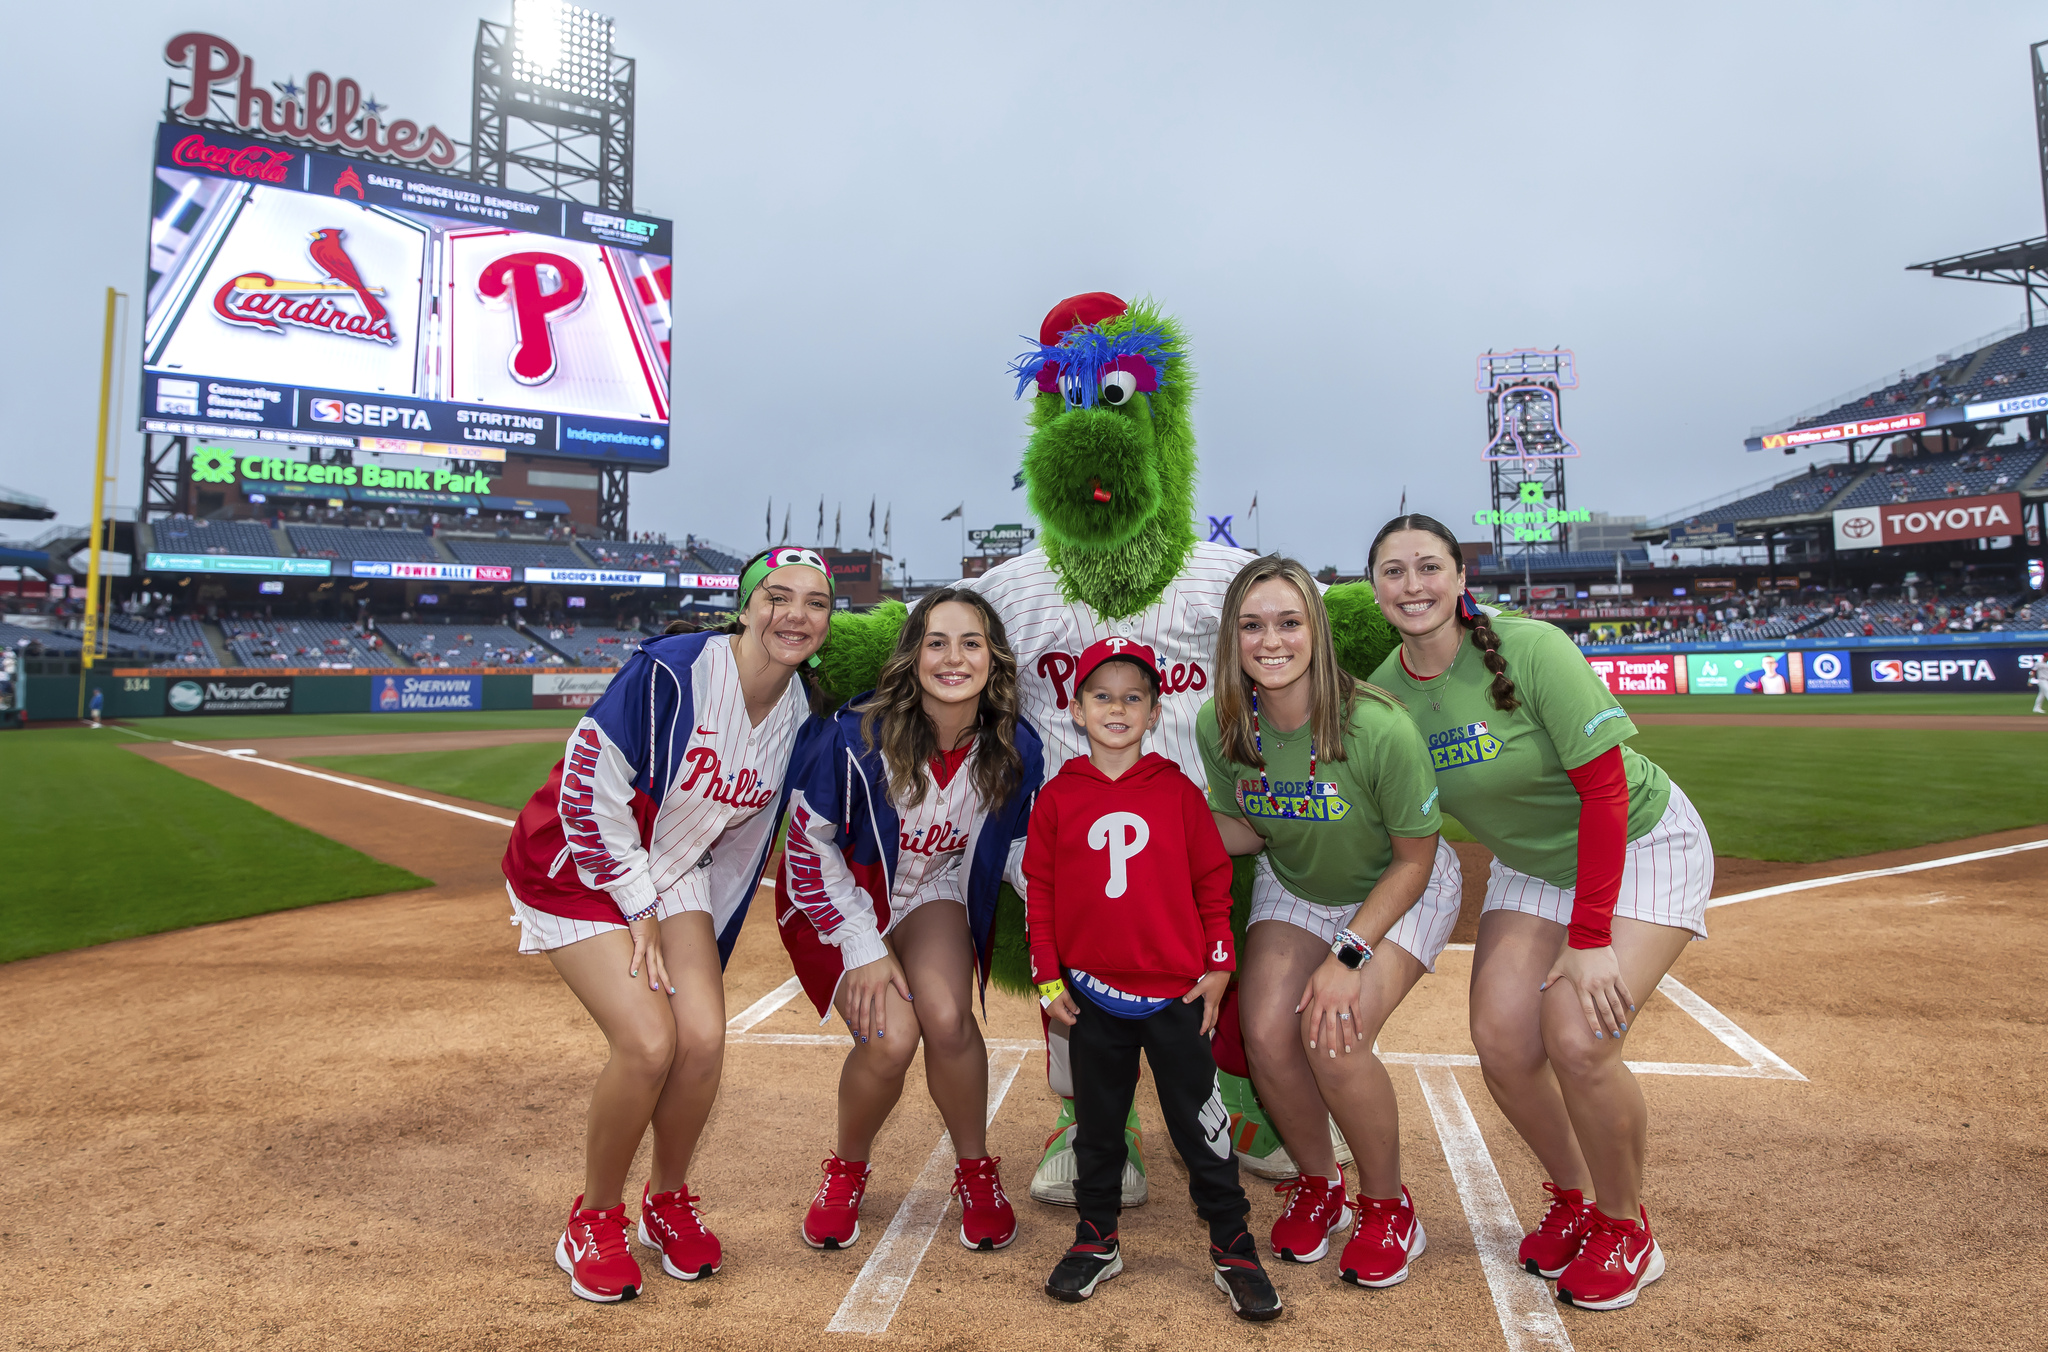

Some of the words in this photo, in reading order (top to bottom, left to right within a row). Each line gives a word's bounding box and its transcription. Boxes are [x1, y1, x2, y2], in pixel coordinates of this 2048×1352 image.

[164, 32, 457, 168] Phillies
[367, 174, 404, 190] SALTZ
[484, 195, 541, 215] BENDESKY
[402, 192, 448, 209] INJURY
[454, 202, 509, 220] LAWYERS
[625, 219, 659, 237] BET
[212, 273, 398, 346] Cardinals
[476, 251, 588, 387] P
[208, 383, 281, 403] Connecting
[344, 403, 432, 431] SEPTA
[456, 409, 544, 430] STARTING
[463, 426, 536, 446] LINEUPS
[566, 427, 650, 447] Independence
[240, 455, 358, 486] Citizens
[361, 463, 430, 490] Bank
[433, 468, 491, 495] Park
[1475, 509, 1544, 525] Citizens
[1546, 506, 1591, 523] Bank
[1886, 505, 2010, 535] TOYOTA
[1514, 525, 1553, 541] Park
[396, 565, 437, 577] POWER
[440, 567, 473, 578] ALLEY
[550, 571, 597, 582] LISCIO'S
[600, 572, 642, 584] BAKERY
[832, 563, 868, 575] GIANT
[700, 576, 739, 588] TOYOTA
[1105, 637, 1128, 655] P
[1616, 660, 1669, 676] Temple
[1903, 659, 1996, 681] SEPTA
[124, 678, 150, 691] 334
[205, 681, 291, 701] NovaCare
[403, 677, 472, 693] SHERWIN
[1618, 676, 1667, 692] Health
[1428, 726, 1465, 747] GOES
[1431, 740, 1479, 769] EEN
[680, 747, 777, 809] Phillie
[561, 728, 632, 887] PHILADELPHIA
[1245, 794, 1325, 819] GREEN
[900, 818, 970, 856] hillie
[1087, 811, 1150, 899] P
